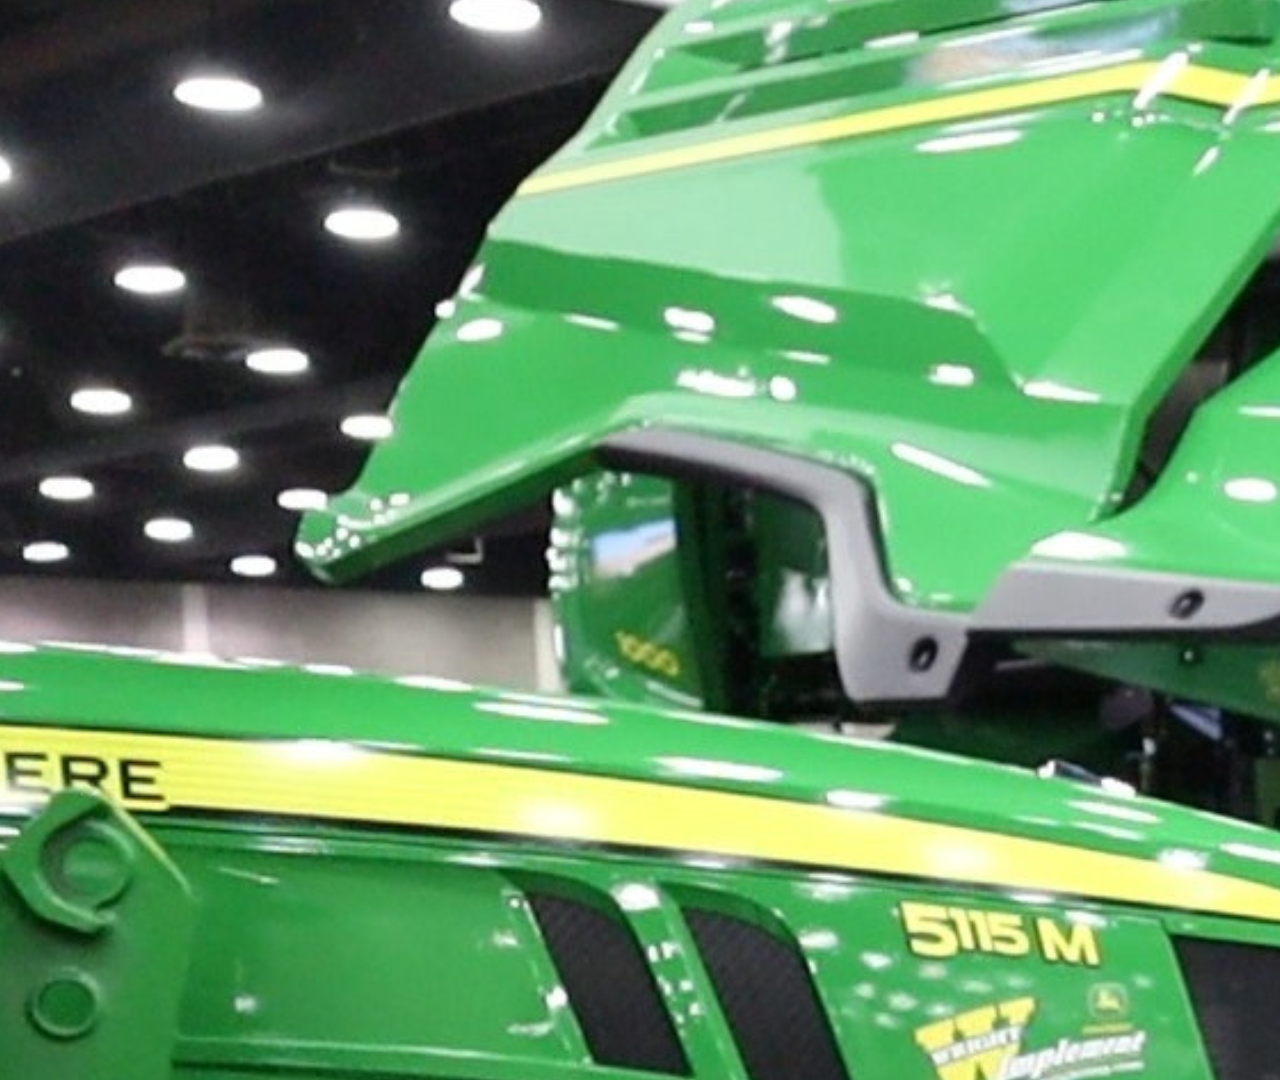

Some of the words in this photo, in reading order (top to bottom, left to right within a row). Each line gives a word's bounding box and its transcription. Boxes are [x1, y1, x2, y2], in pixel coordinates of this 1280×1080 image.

[900, 901, 1031, 959] 5115
[1036, 916, 1101, 967] M
[930, 1025, 1024, 1067] WRIGHT
